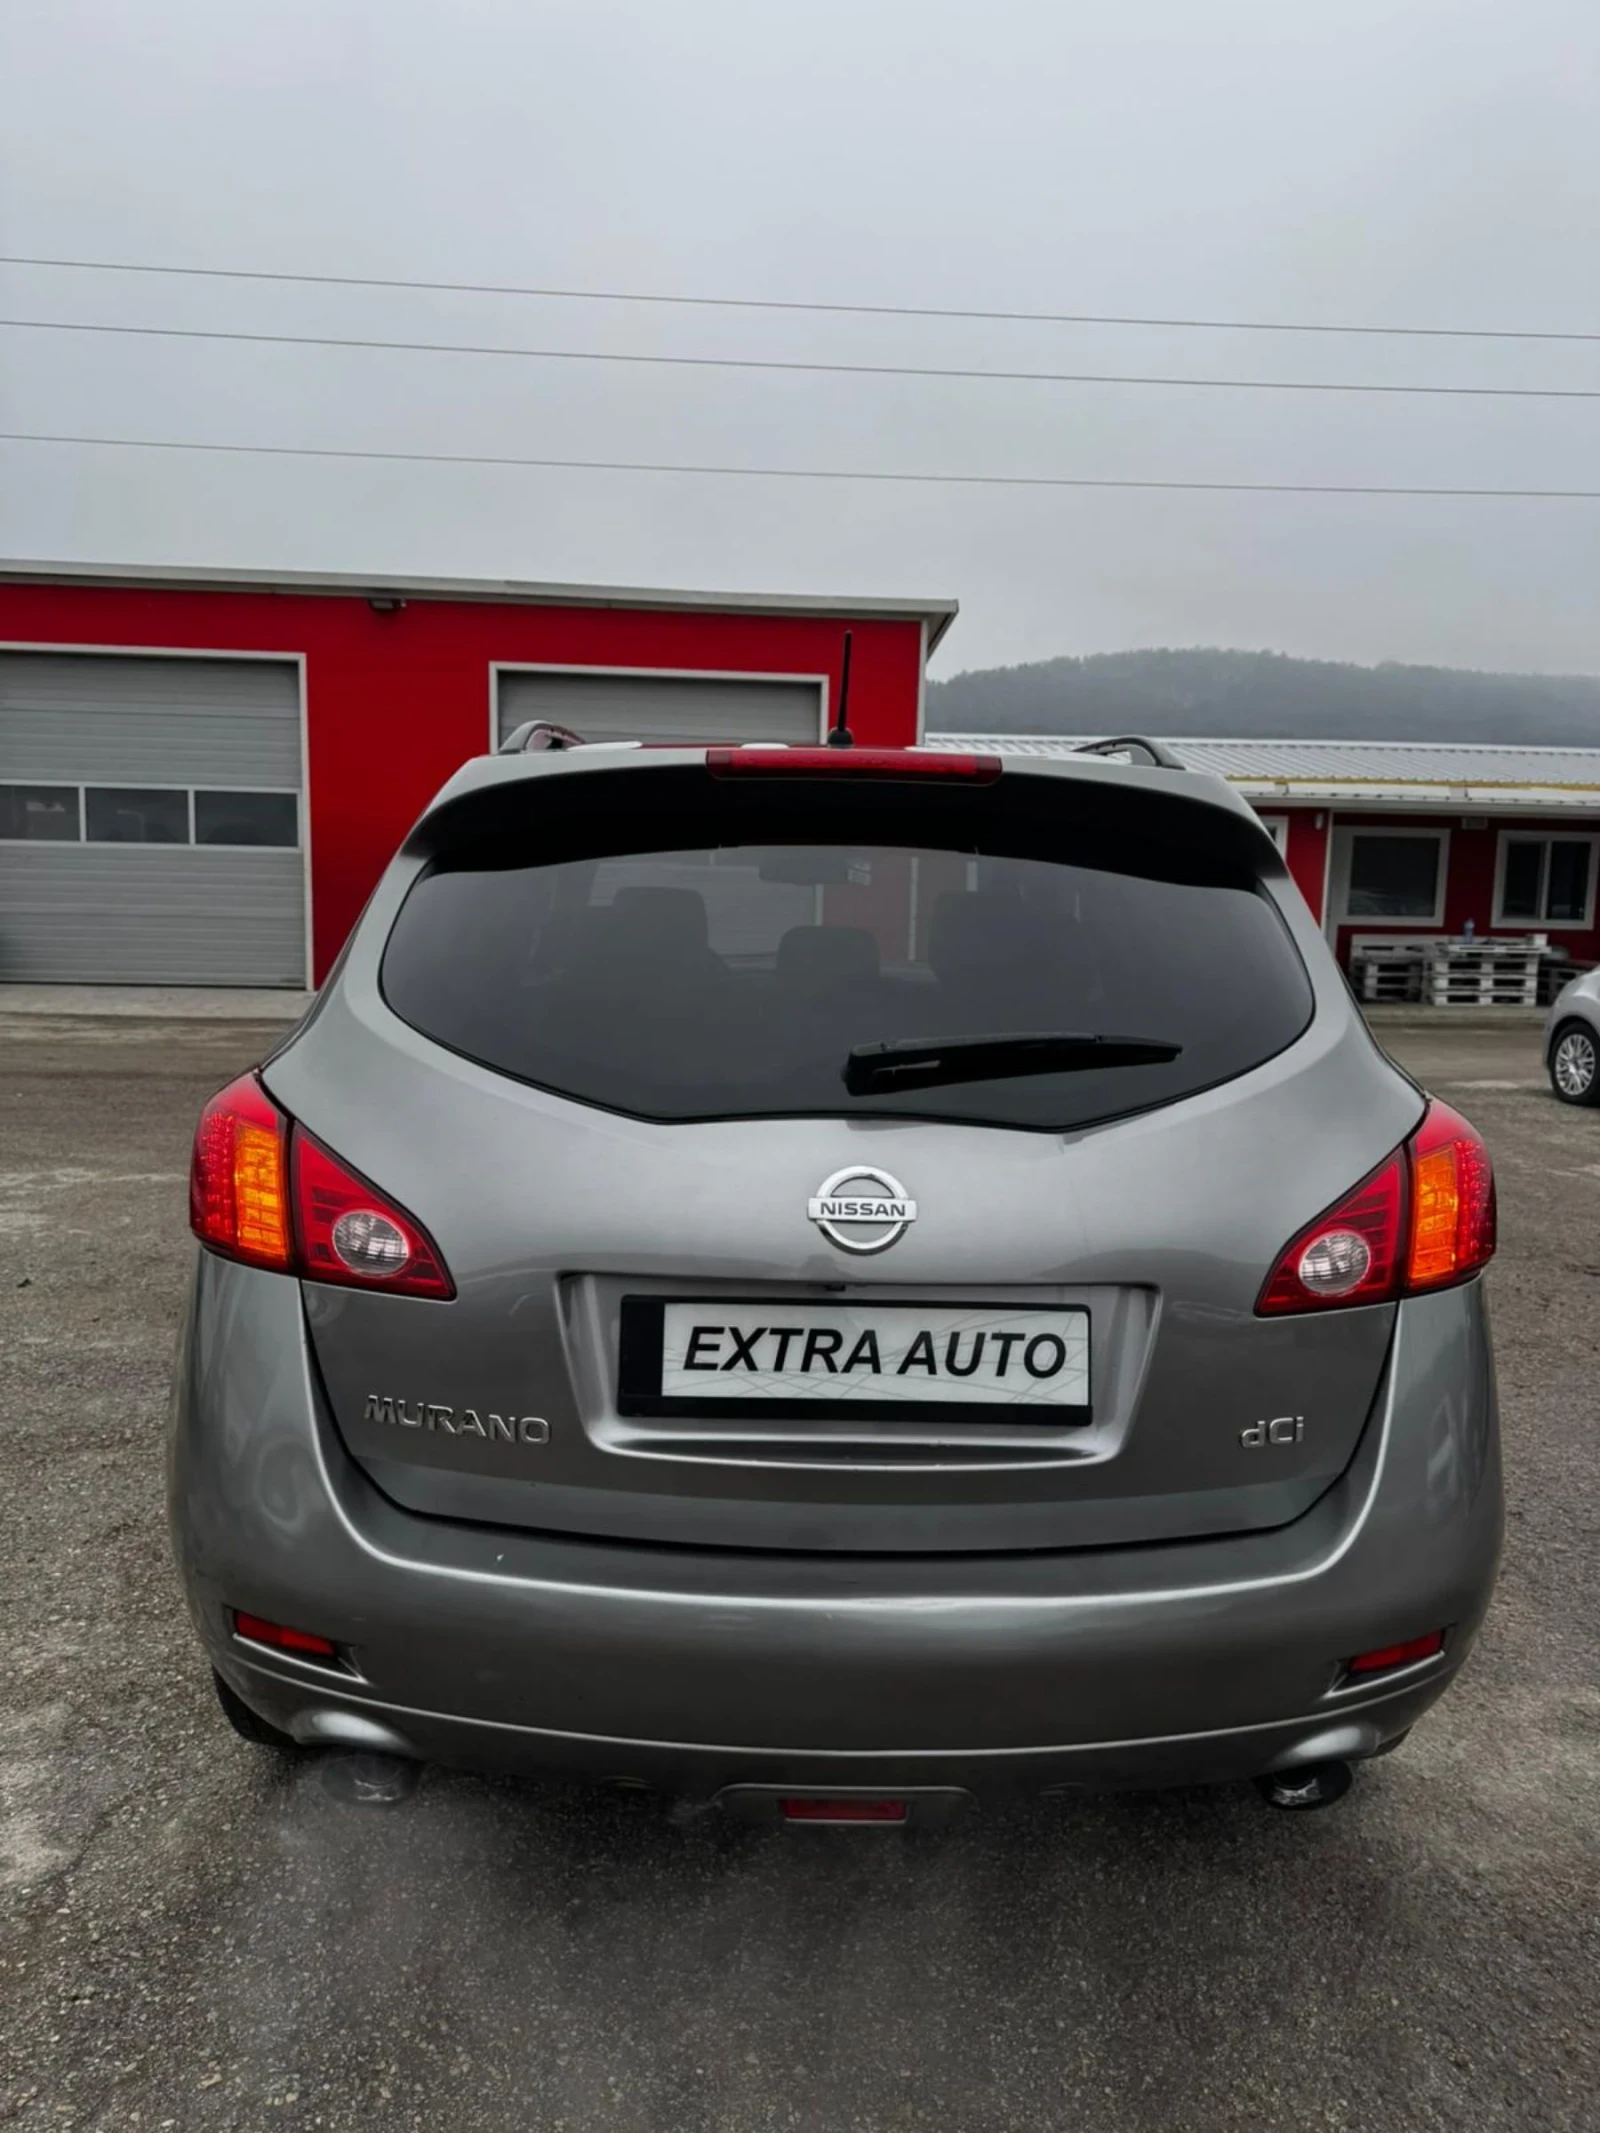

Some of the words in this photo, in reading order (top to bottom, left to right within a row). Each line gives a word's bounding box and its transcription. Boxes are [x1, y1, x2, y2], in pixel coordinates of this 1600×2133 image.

[820, 1202, 906, 1217] NISSAN
[683, 1326, 882, 1374] EXTRA
[897, 1331, 1067, 1379] AUTO
[364, 1394, 549, 1444] MURANO
[1242, 1416, 1304, 1447] dCi
